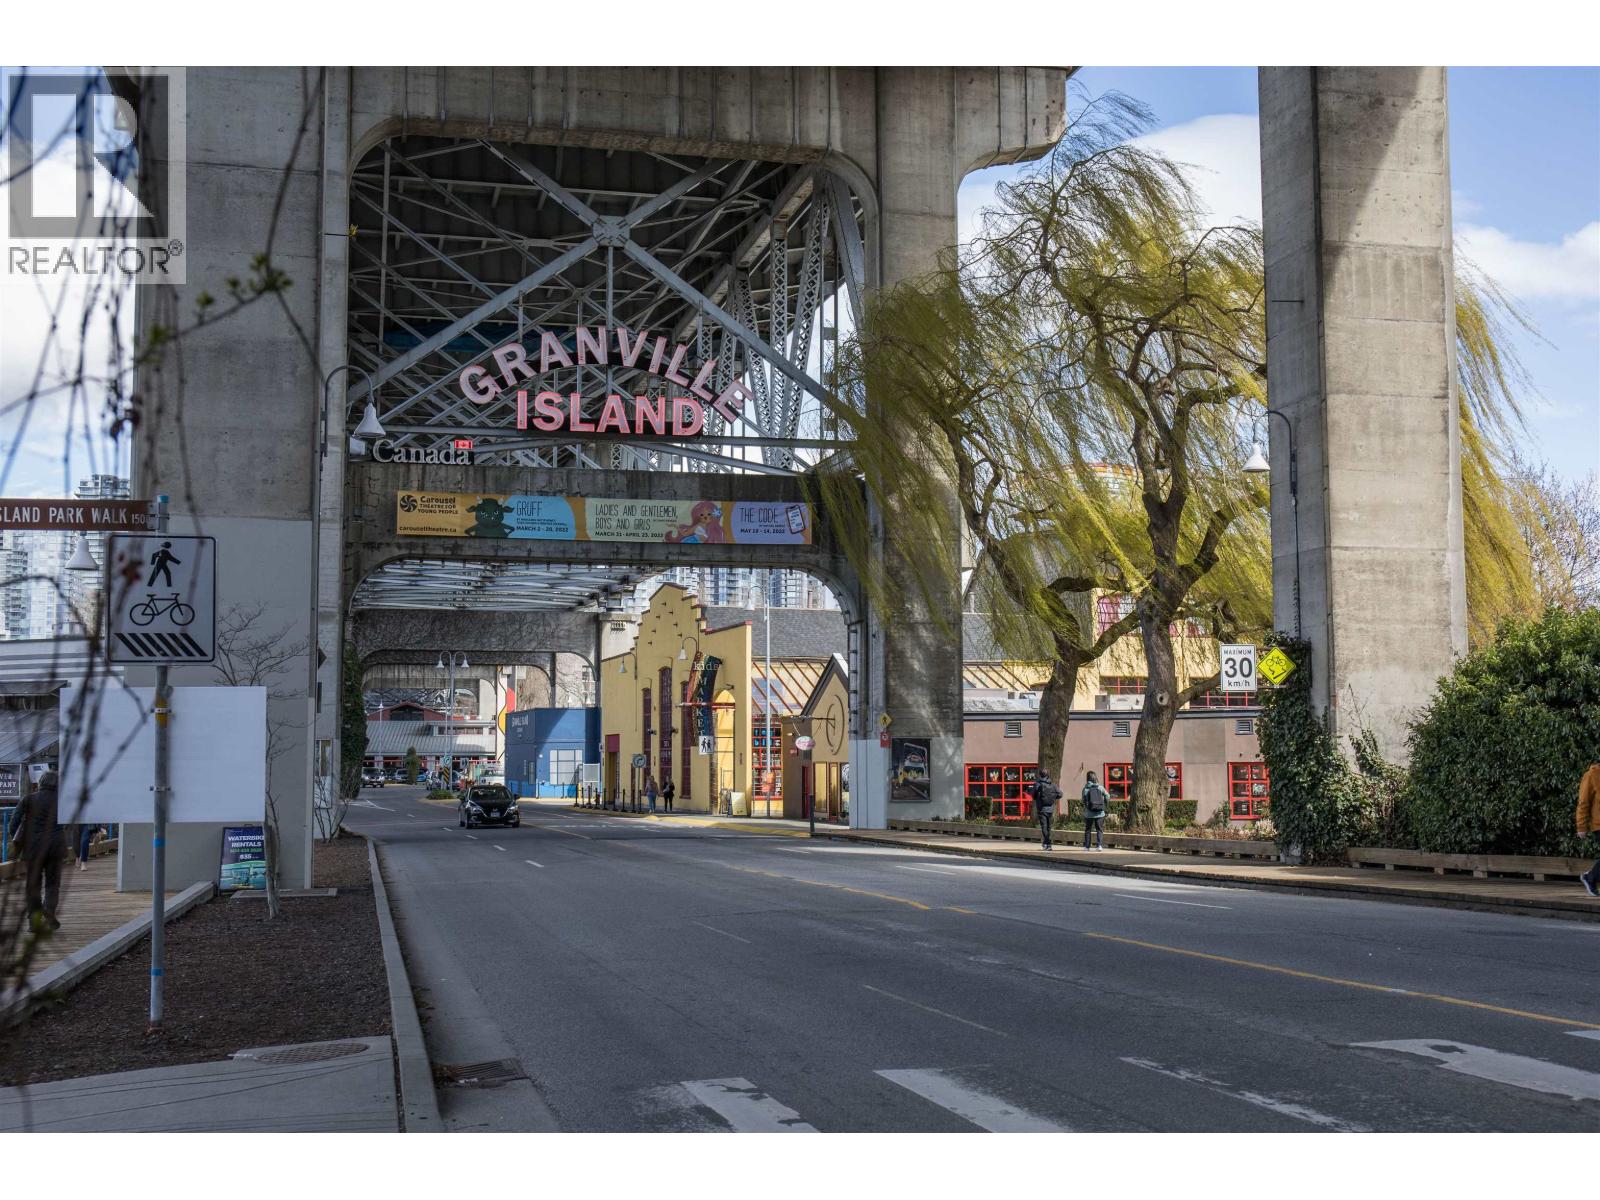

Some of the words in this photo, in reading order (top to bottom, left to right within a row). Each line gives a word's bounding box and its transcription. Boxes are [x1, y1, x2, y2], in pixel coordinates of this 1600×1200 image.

[458, 326, 756, 424] GRANVILLE
[516, 390, 705, 436] ISLAND
[372, 439, 472, 465] Canada
[420, 495, 456, 504] Carousel
[49, 507, 84, 524] PARK
[91, 507, 127, 525] WALK
[516, 500, 543, 517] GRUFF
[595, 503, 619, 517] LADIES
[622, 504, 637, 517] AND
[640, 504, 678, 519] GENTLEMEN,
[740, 507, 754, 523] THE
[758, 507, 778, 523] CODE
[399, 525, 457, 533] carouseltheatre.ca
[595, 517, 612, 530] BOYS
[616, 518, 630, 530] AND
[634, 518, 651, 531] GIRLS
[1224, 657, 1253, 678] 30
[1227, 679, 1250, 687] km/h
